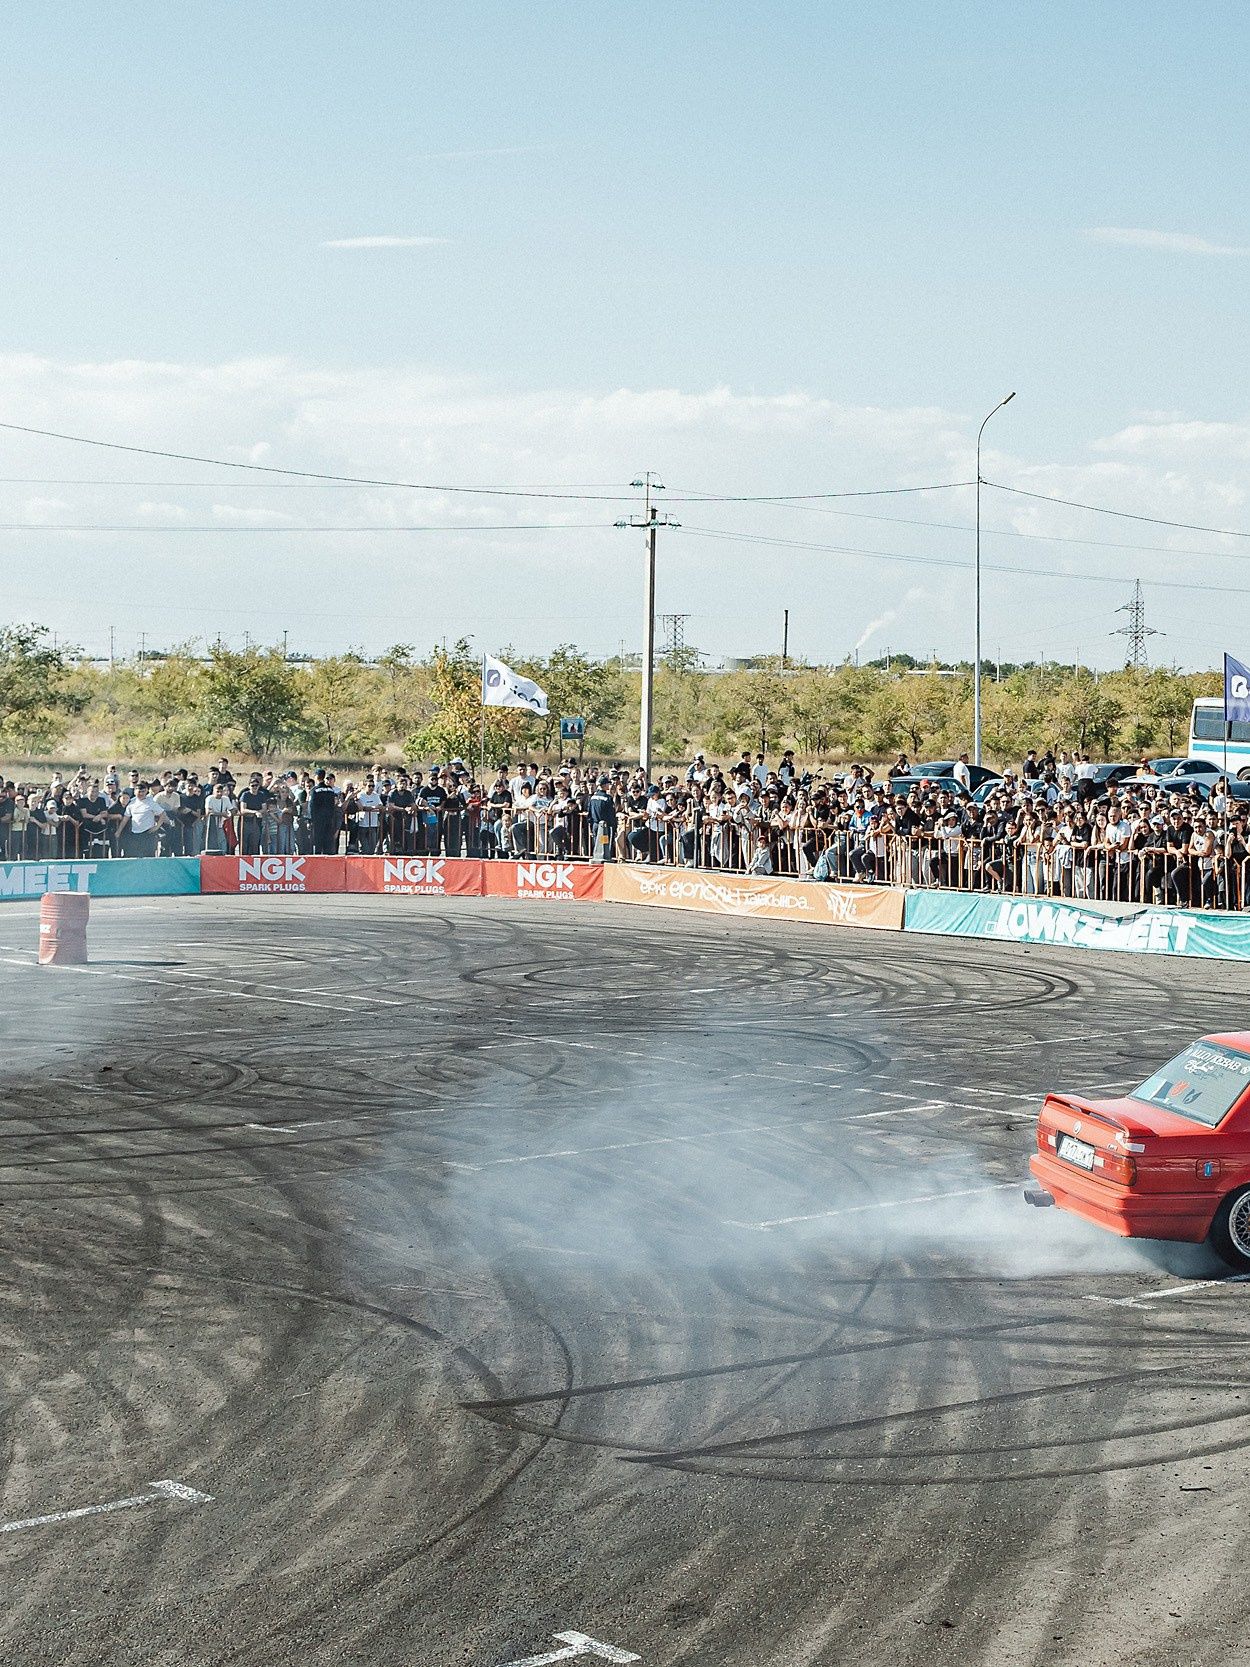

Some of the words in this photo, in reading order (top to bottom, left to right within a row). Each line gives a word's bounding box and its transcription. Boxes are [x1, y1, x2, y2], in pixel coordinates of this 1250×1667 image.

[239, 857, 306, 882] NGK
[383, 858, 446, 884] NGK
[517, 863, 575, 889] NGK
[239, 883, 271, 891] SPARK
[273, 883, 306, 891] PLUGS
[384, 884, 413, 893] SPARK
[414, 885, 445, 894] PLUGS
[517, 889, 544, 898] SPARK
[546, 890, 574, 899] PLUGS
